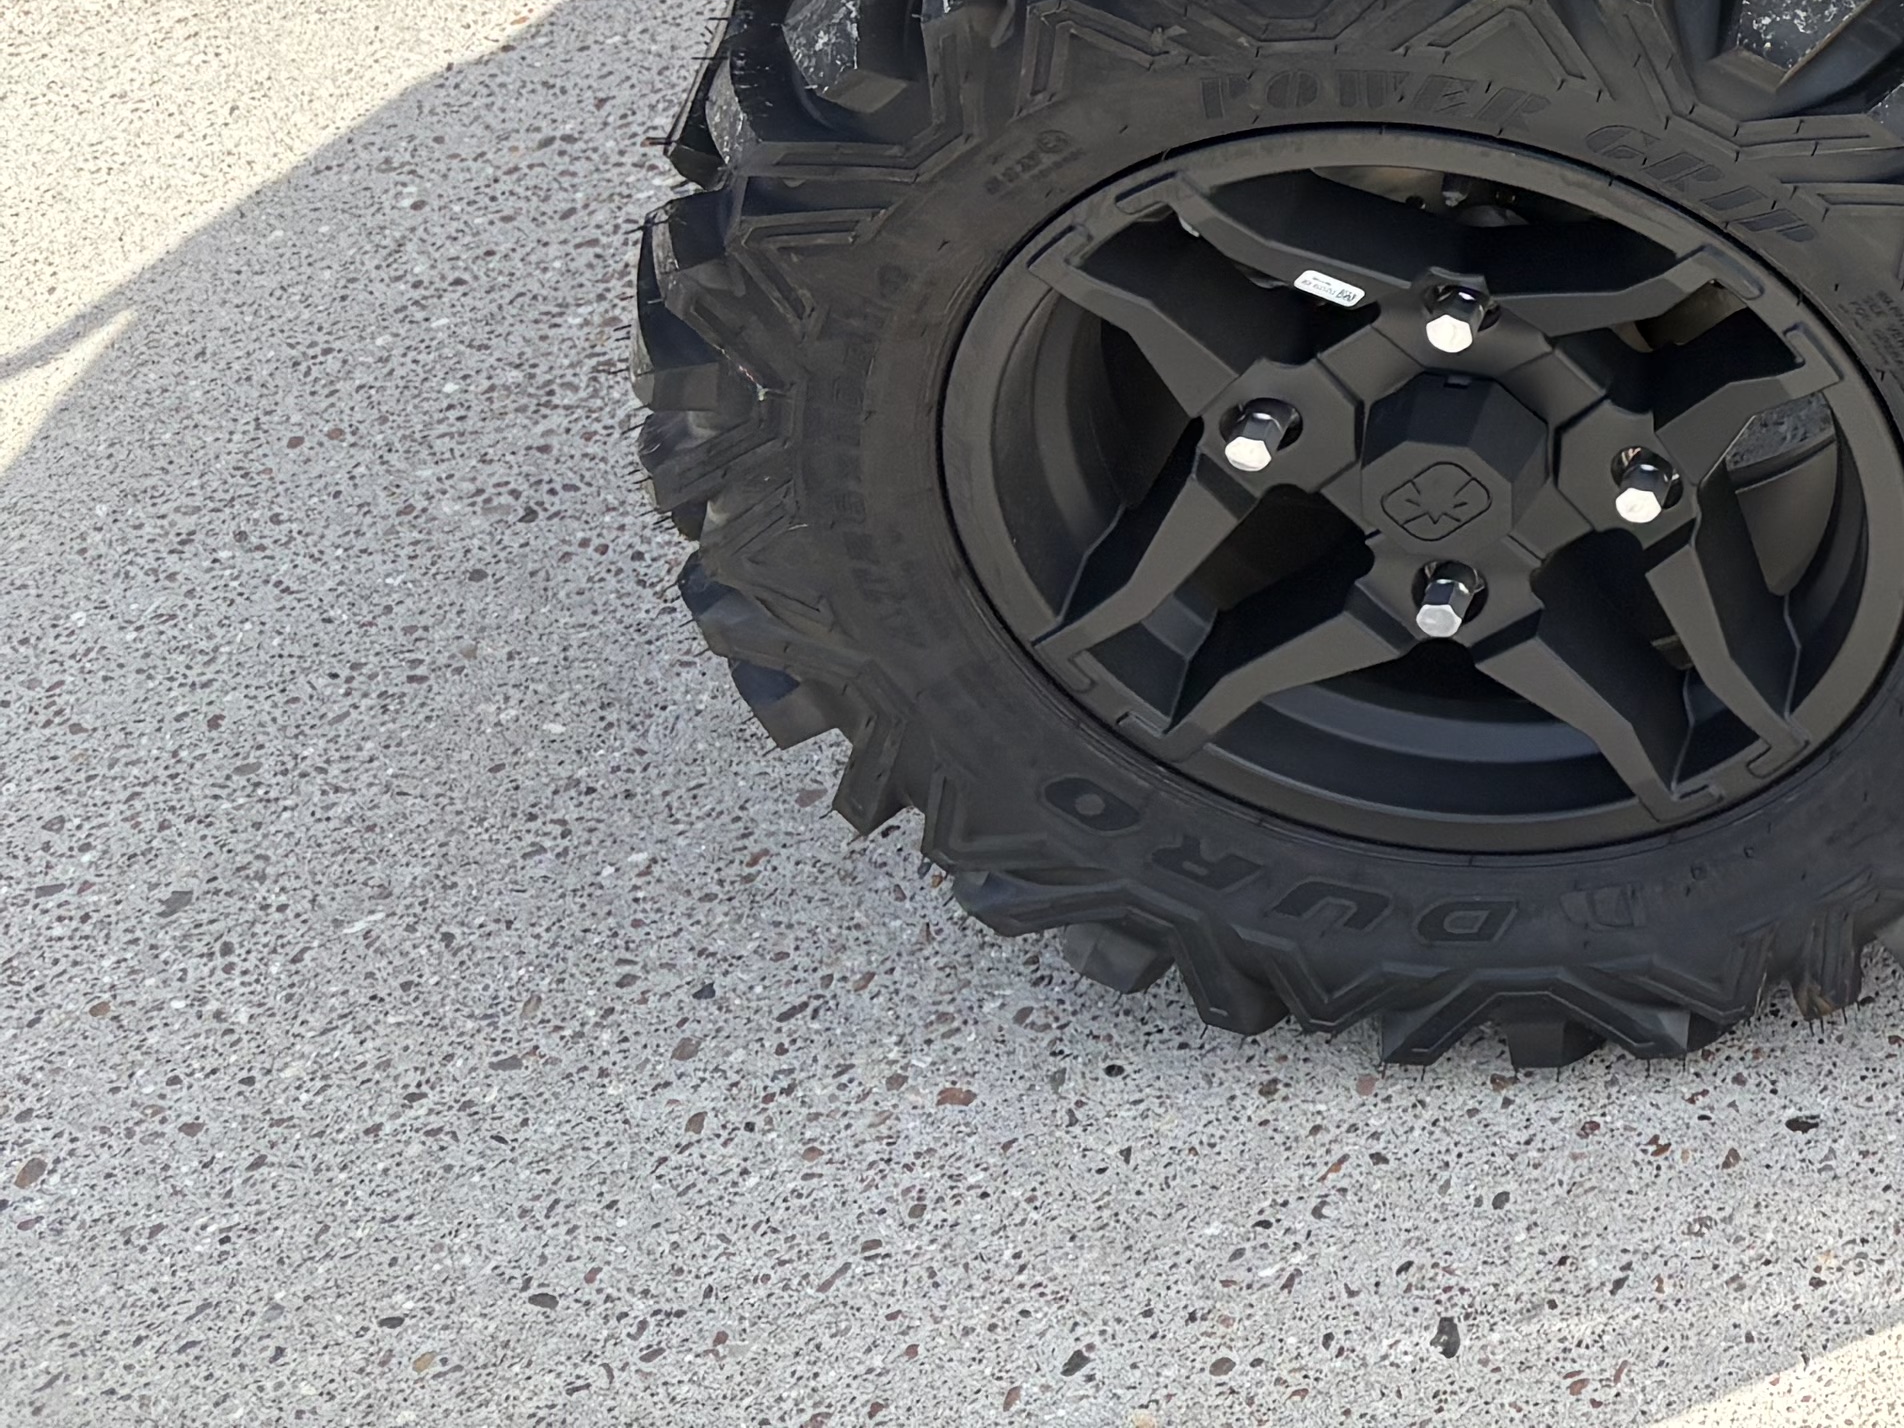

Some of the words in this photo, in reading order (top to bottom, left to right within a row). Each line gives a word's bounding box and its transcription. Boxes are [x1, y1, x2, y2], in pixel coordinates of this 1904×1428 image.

[1199, 68, 1551, 135] POWER
[1585, 124, 1818, 242] GRIP
[1036, 774, 1518, 943] DURO
